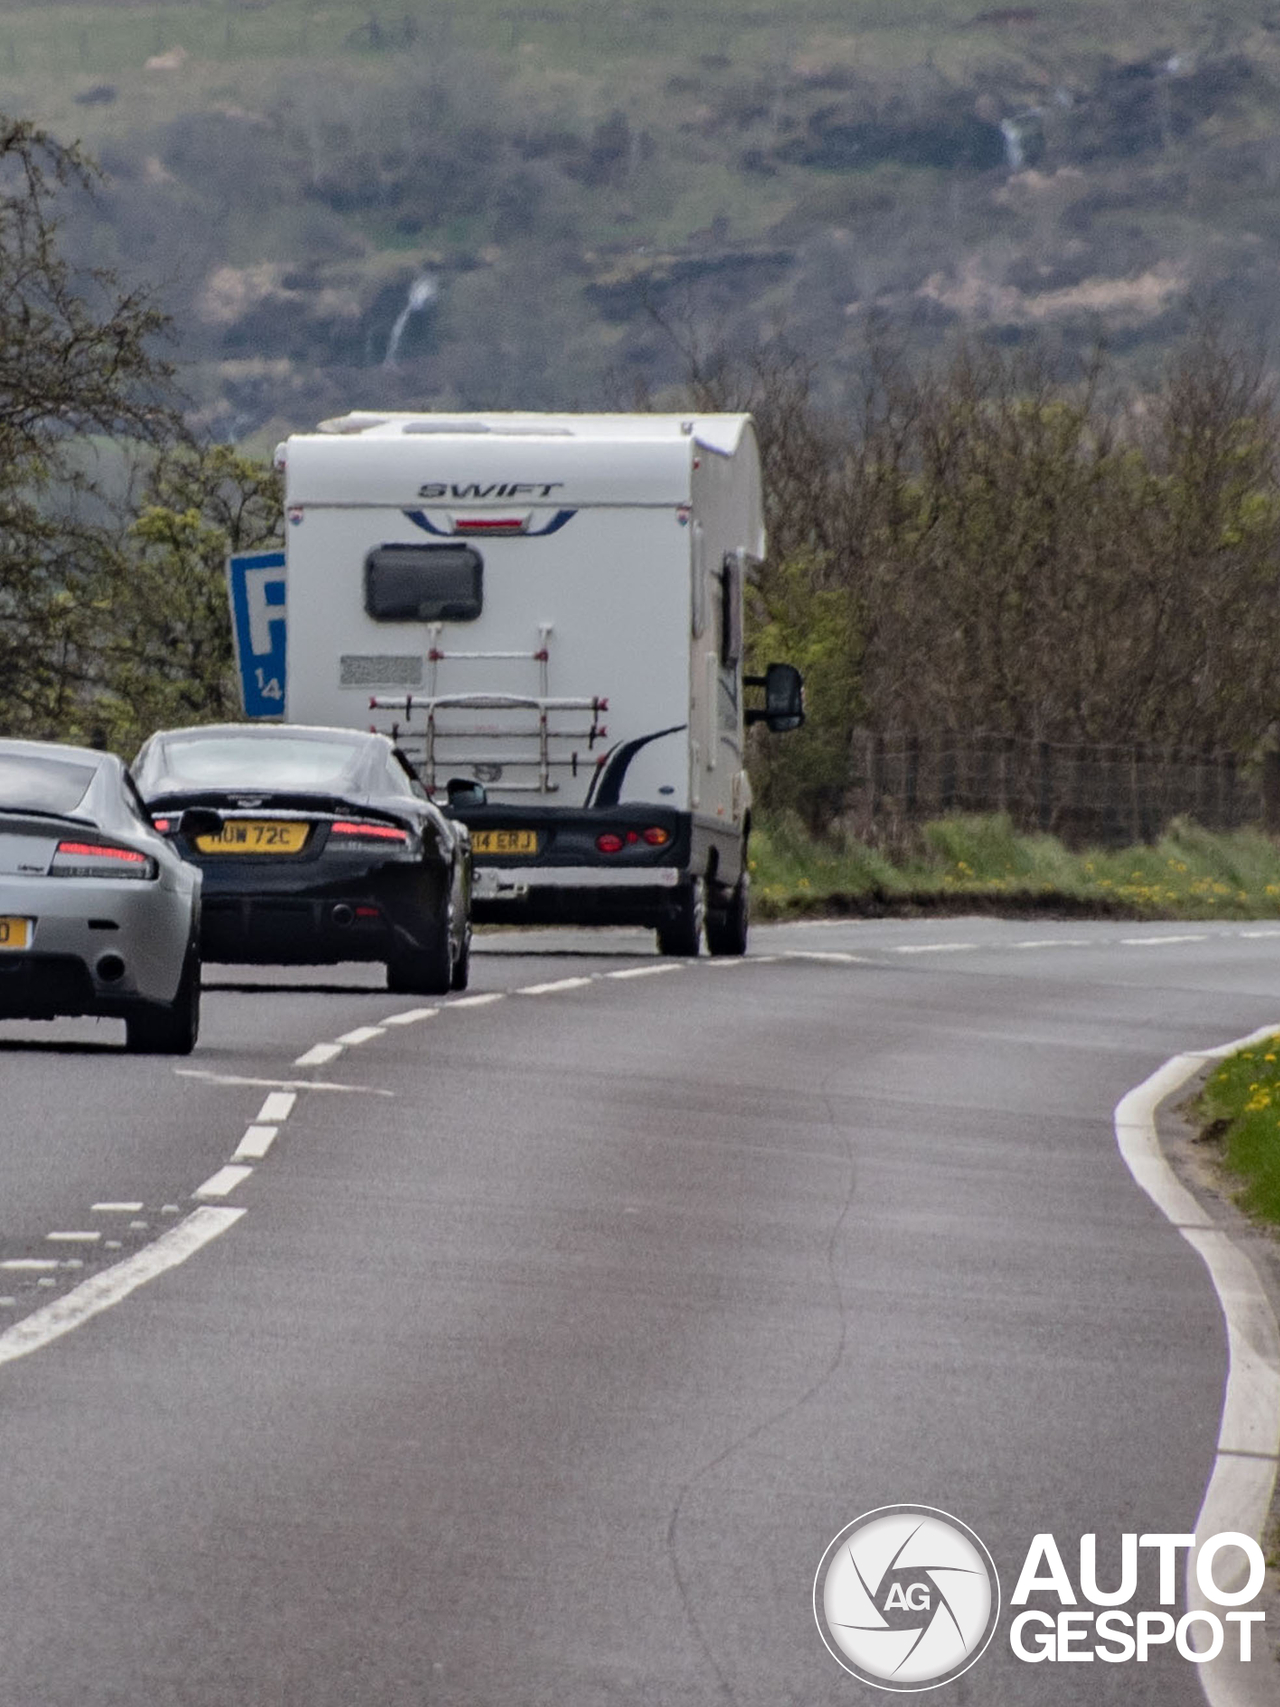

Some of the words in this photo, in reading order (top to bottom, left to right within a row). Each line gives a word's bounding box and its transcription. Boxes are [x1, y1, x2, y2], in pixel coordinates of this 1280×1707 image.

[418, 482, 565, 499] SWIFT
[254, 825, 291, 845] 72C
[497, 831, 531, 850] ERJ
